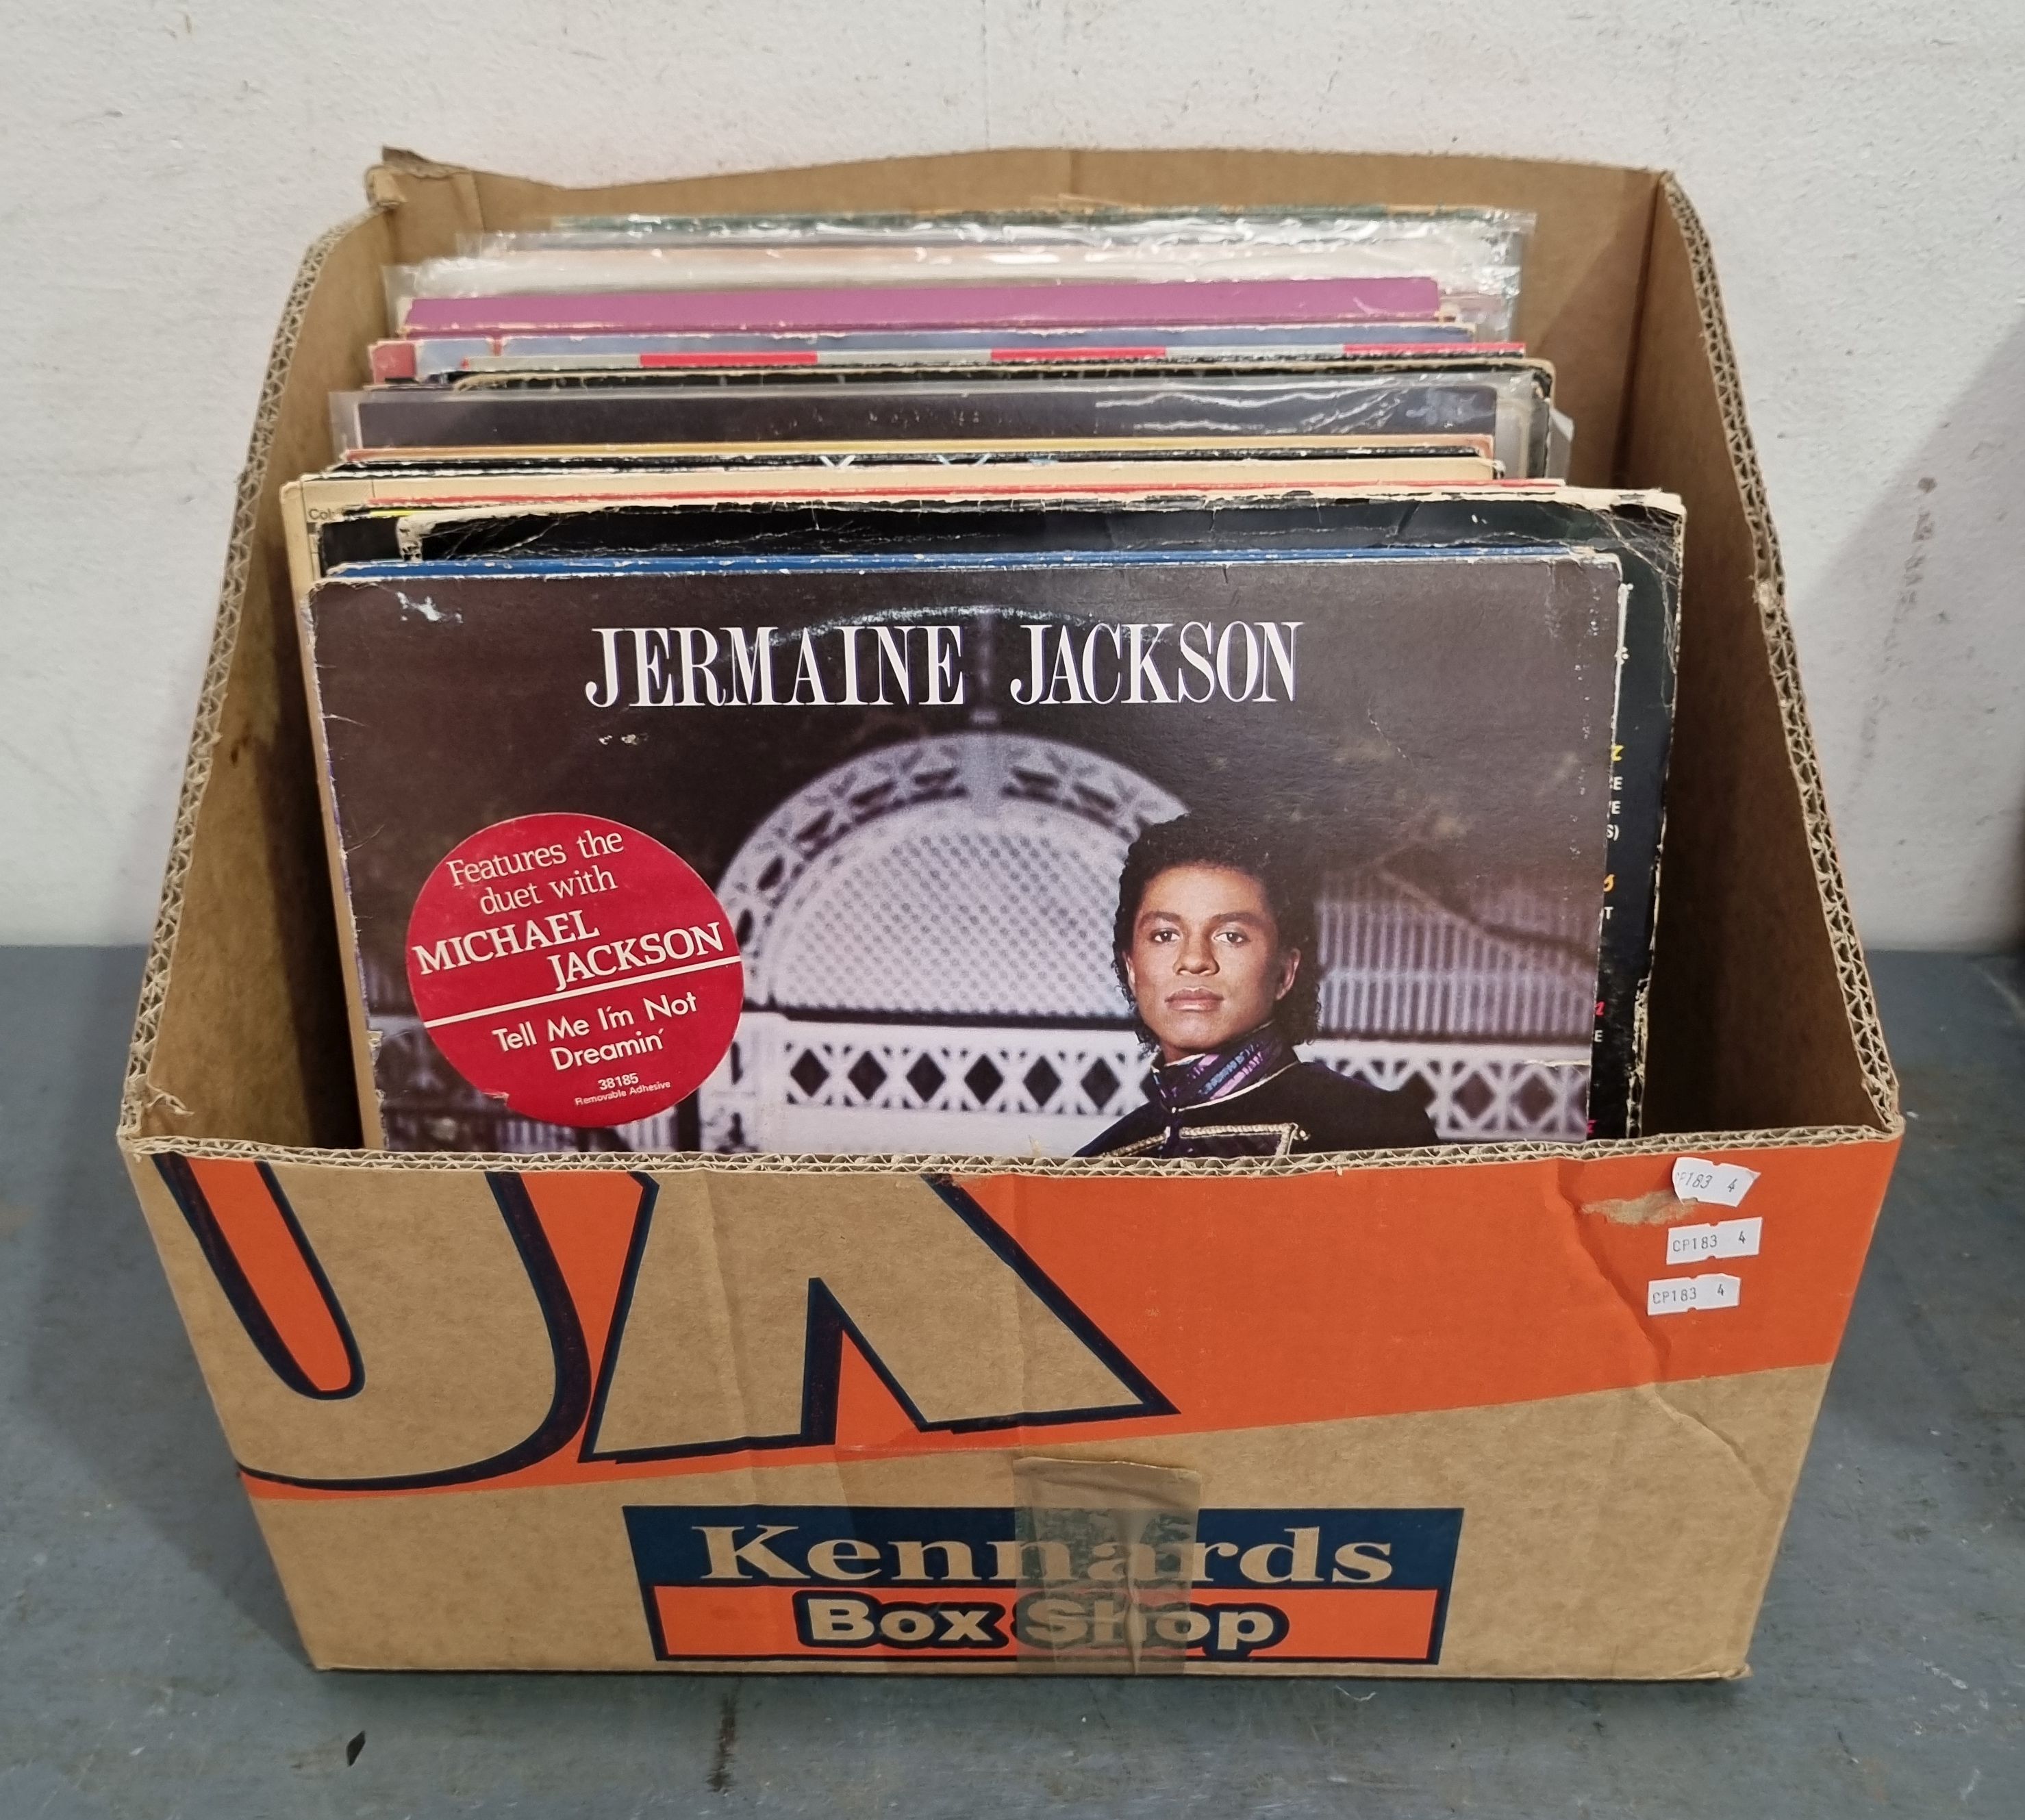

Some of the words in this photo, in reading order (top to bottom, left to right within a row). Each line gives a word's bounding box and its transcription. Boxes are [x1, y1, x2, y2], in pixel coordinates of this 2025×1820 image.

[584, 625, 966, 709] JERMAINE
[1009, 620, 1304, 706] JACKSON
[446, 843, 567, 887] Features
[577, 829, 625, 861] the
[479, 883, 543, 915] duet
[549, 865, 618, 900] with
[412, 909, 600, 975] MICHAEL
[546, 922, 725, 992] JACKSON
[492, 1021, 538, 1052] Tell
[547, 1015, 590, 1042] Me
[642, 991, 697, 1022] Not
[574, 1089, 627, 1107] Removable
[629, 1080, 672, 1096] Adhesive
[597, 1072, 639, 1091] 38185
[1726, 1178, 1738, 1193] 4
[1672, 1234, 1718, 1252] CP183
[1737, 1230, 1747, 1244] 4
[1652, 1287, 1698, 1304] CP183
[1716, 1283, 1726, 1296] 4
[690, 1524, 1396, 1584] Kennards
[805, 1598, 994, 1643] Box
[1024, 1597, 1275, 1652] Shop
